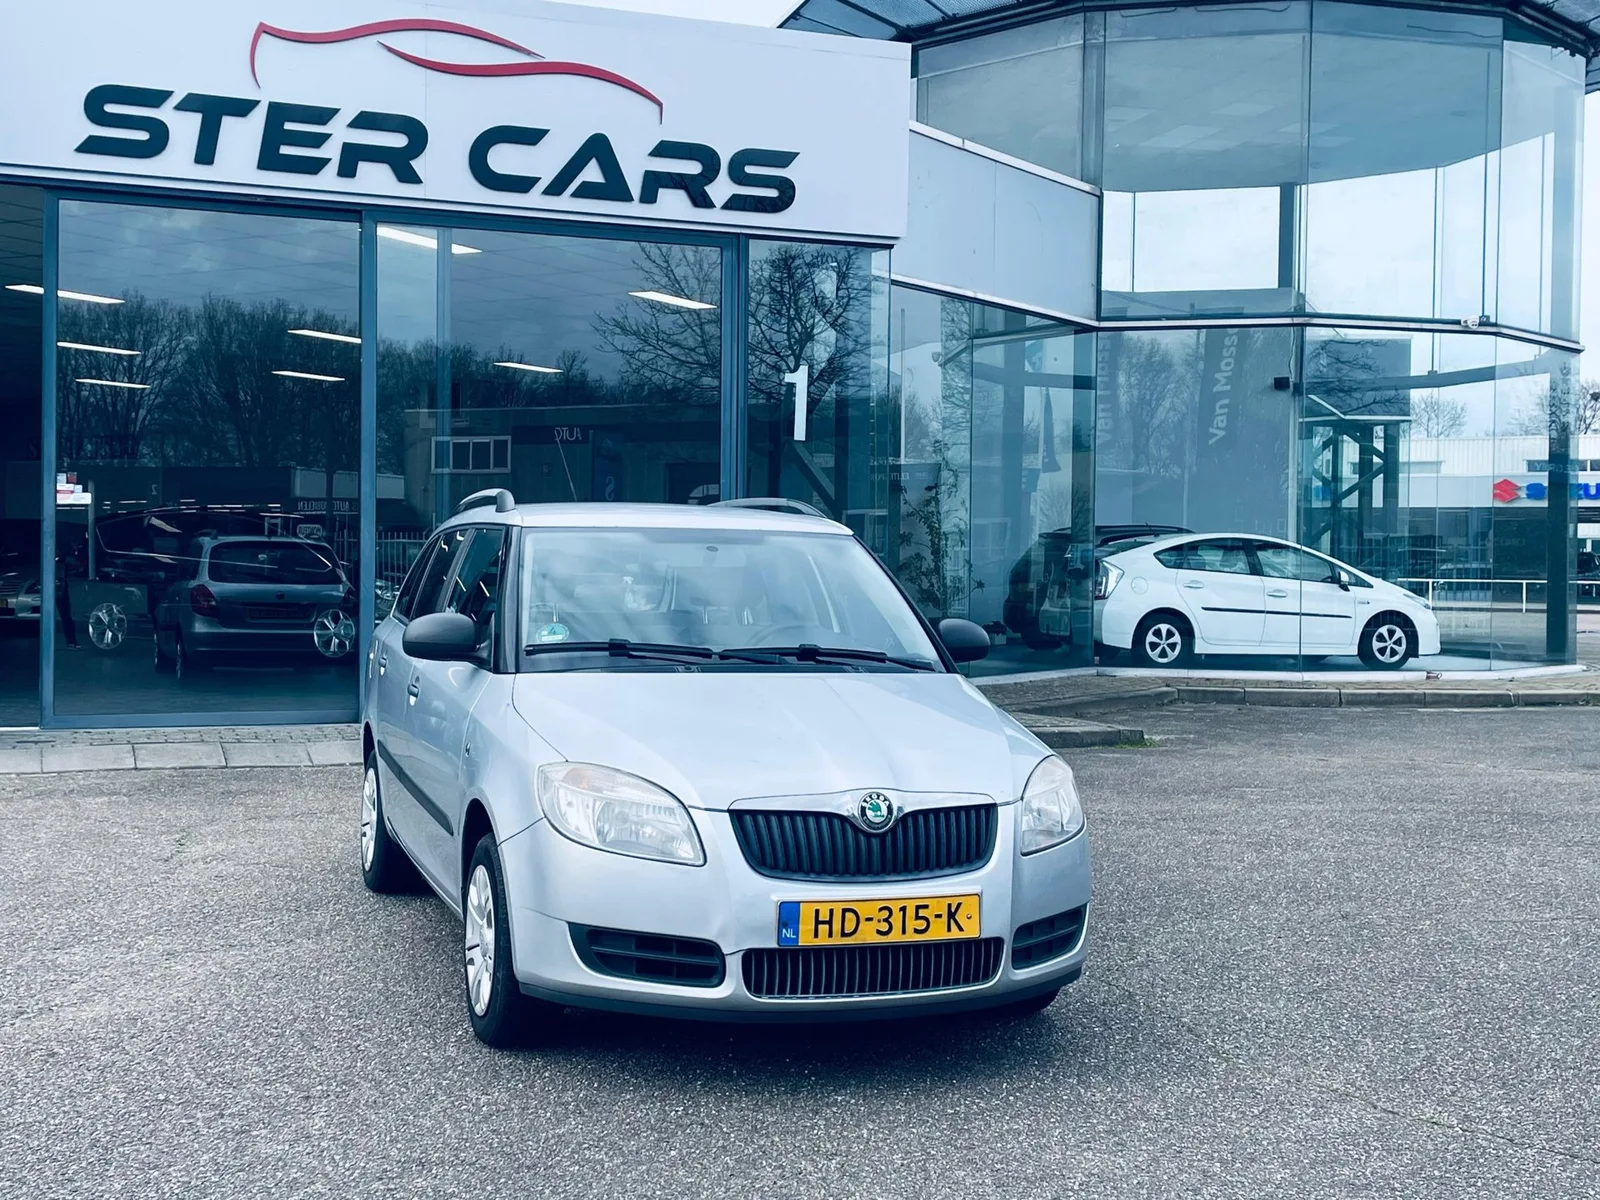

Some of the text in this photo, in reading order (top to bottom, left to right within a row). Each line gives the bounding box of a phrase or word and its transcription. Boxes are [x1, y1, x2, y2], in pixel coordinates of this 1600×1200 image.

[75, 85, 799, 213] STER CARS
[785, 365, 808, 441] 1
[1208, 398, 1230, 446] Van
[1525, 482, 1600, 501] SZU
[782, 928, 797, 939] NL
[813, 901, 965, 939] HD-315-K
